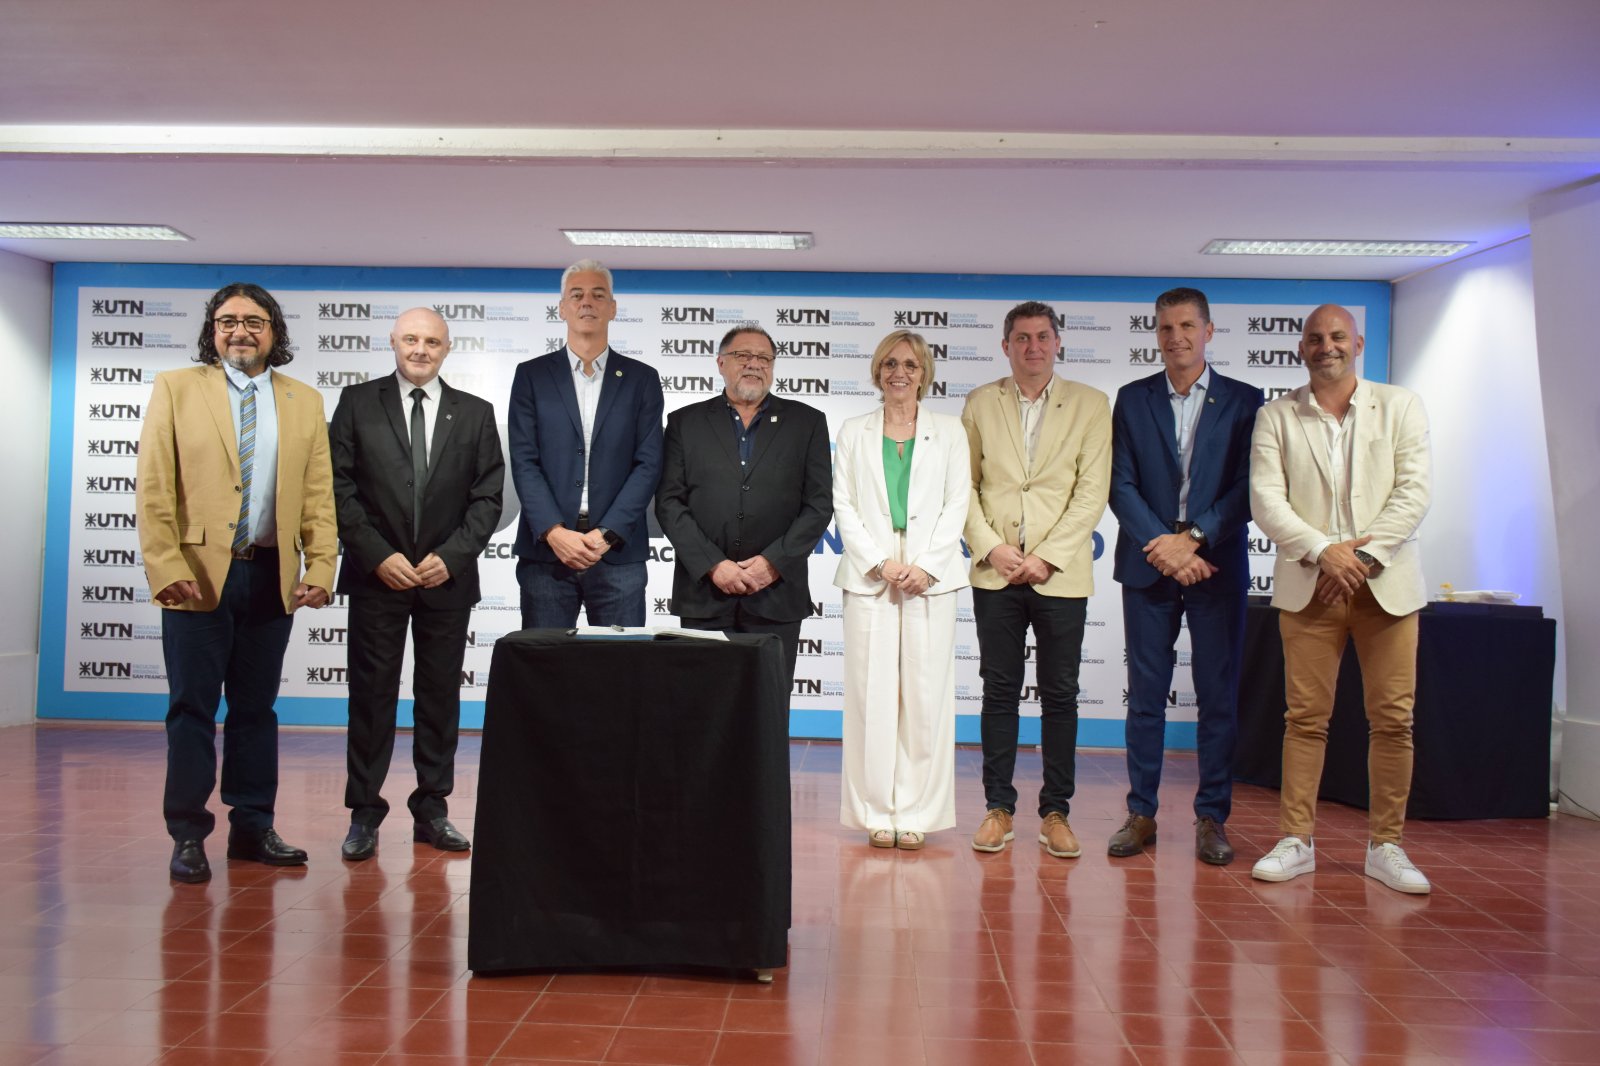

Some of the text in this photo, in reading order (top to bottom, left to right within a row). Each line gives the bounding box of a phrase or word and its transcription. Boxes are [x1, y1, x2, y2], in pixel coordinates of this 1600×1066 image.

[105, 300, 143, 314] UTN
[332, 304, 370, 318] UTN
[446, 305, 484, 319] UTN
[675, 308, 714, 322] UTN
[790, 309, 829, 324] UTN
[907, 311, 948, 326] UTN
[1261, 318, 1302, 332] UTN
[104, 332, 143, 346] UTN
[331, 336, 370, 350] UTN
[674, 340, 714, 354] UTN
[790, 342, 829, 356] UTN
[1261, 350, 1301, 365] UTN
[103, 368, 142, 382] UTN
[330, 372, 369, 386] UTN
[674, 377, 713, 391] UTN
[789, 379, 829, 393] UTN
[102, 404, 140, 418] UTN
[101, 440, 139, 454] UTN
[99, 477, 136, 491] UTN
[98, 514, 136, 528] UTN
[96, 550, 135, 564] UTN
[95, 586, 134, 600] UTN
[94, 623, 132, 637] UTN
[321, 628, 347, 642] UT
[798, 640, 821, 653] TN
[92, 662, 131, 676] UTN
[320, 668, 349, 682] UT
[795, 679, 821, 694] TN
